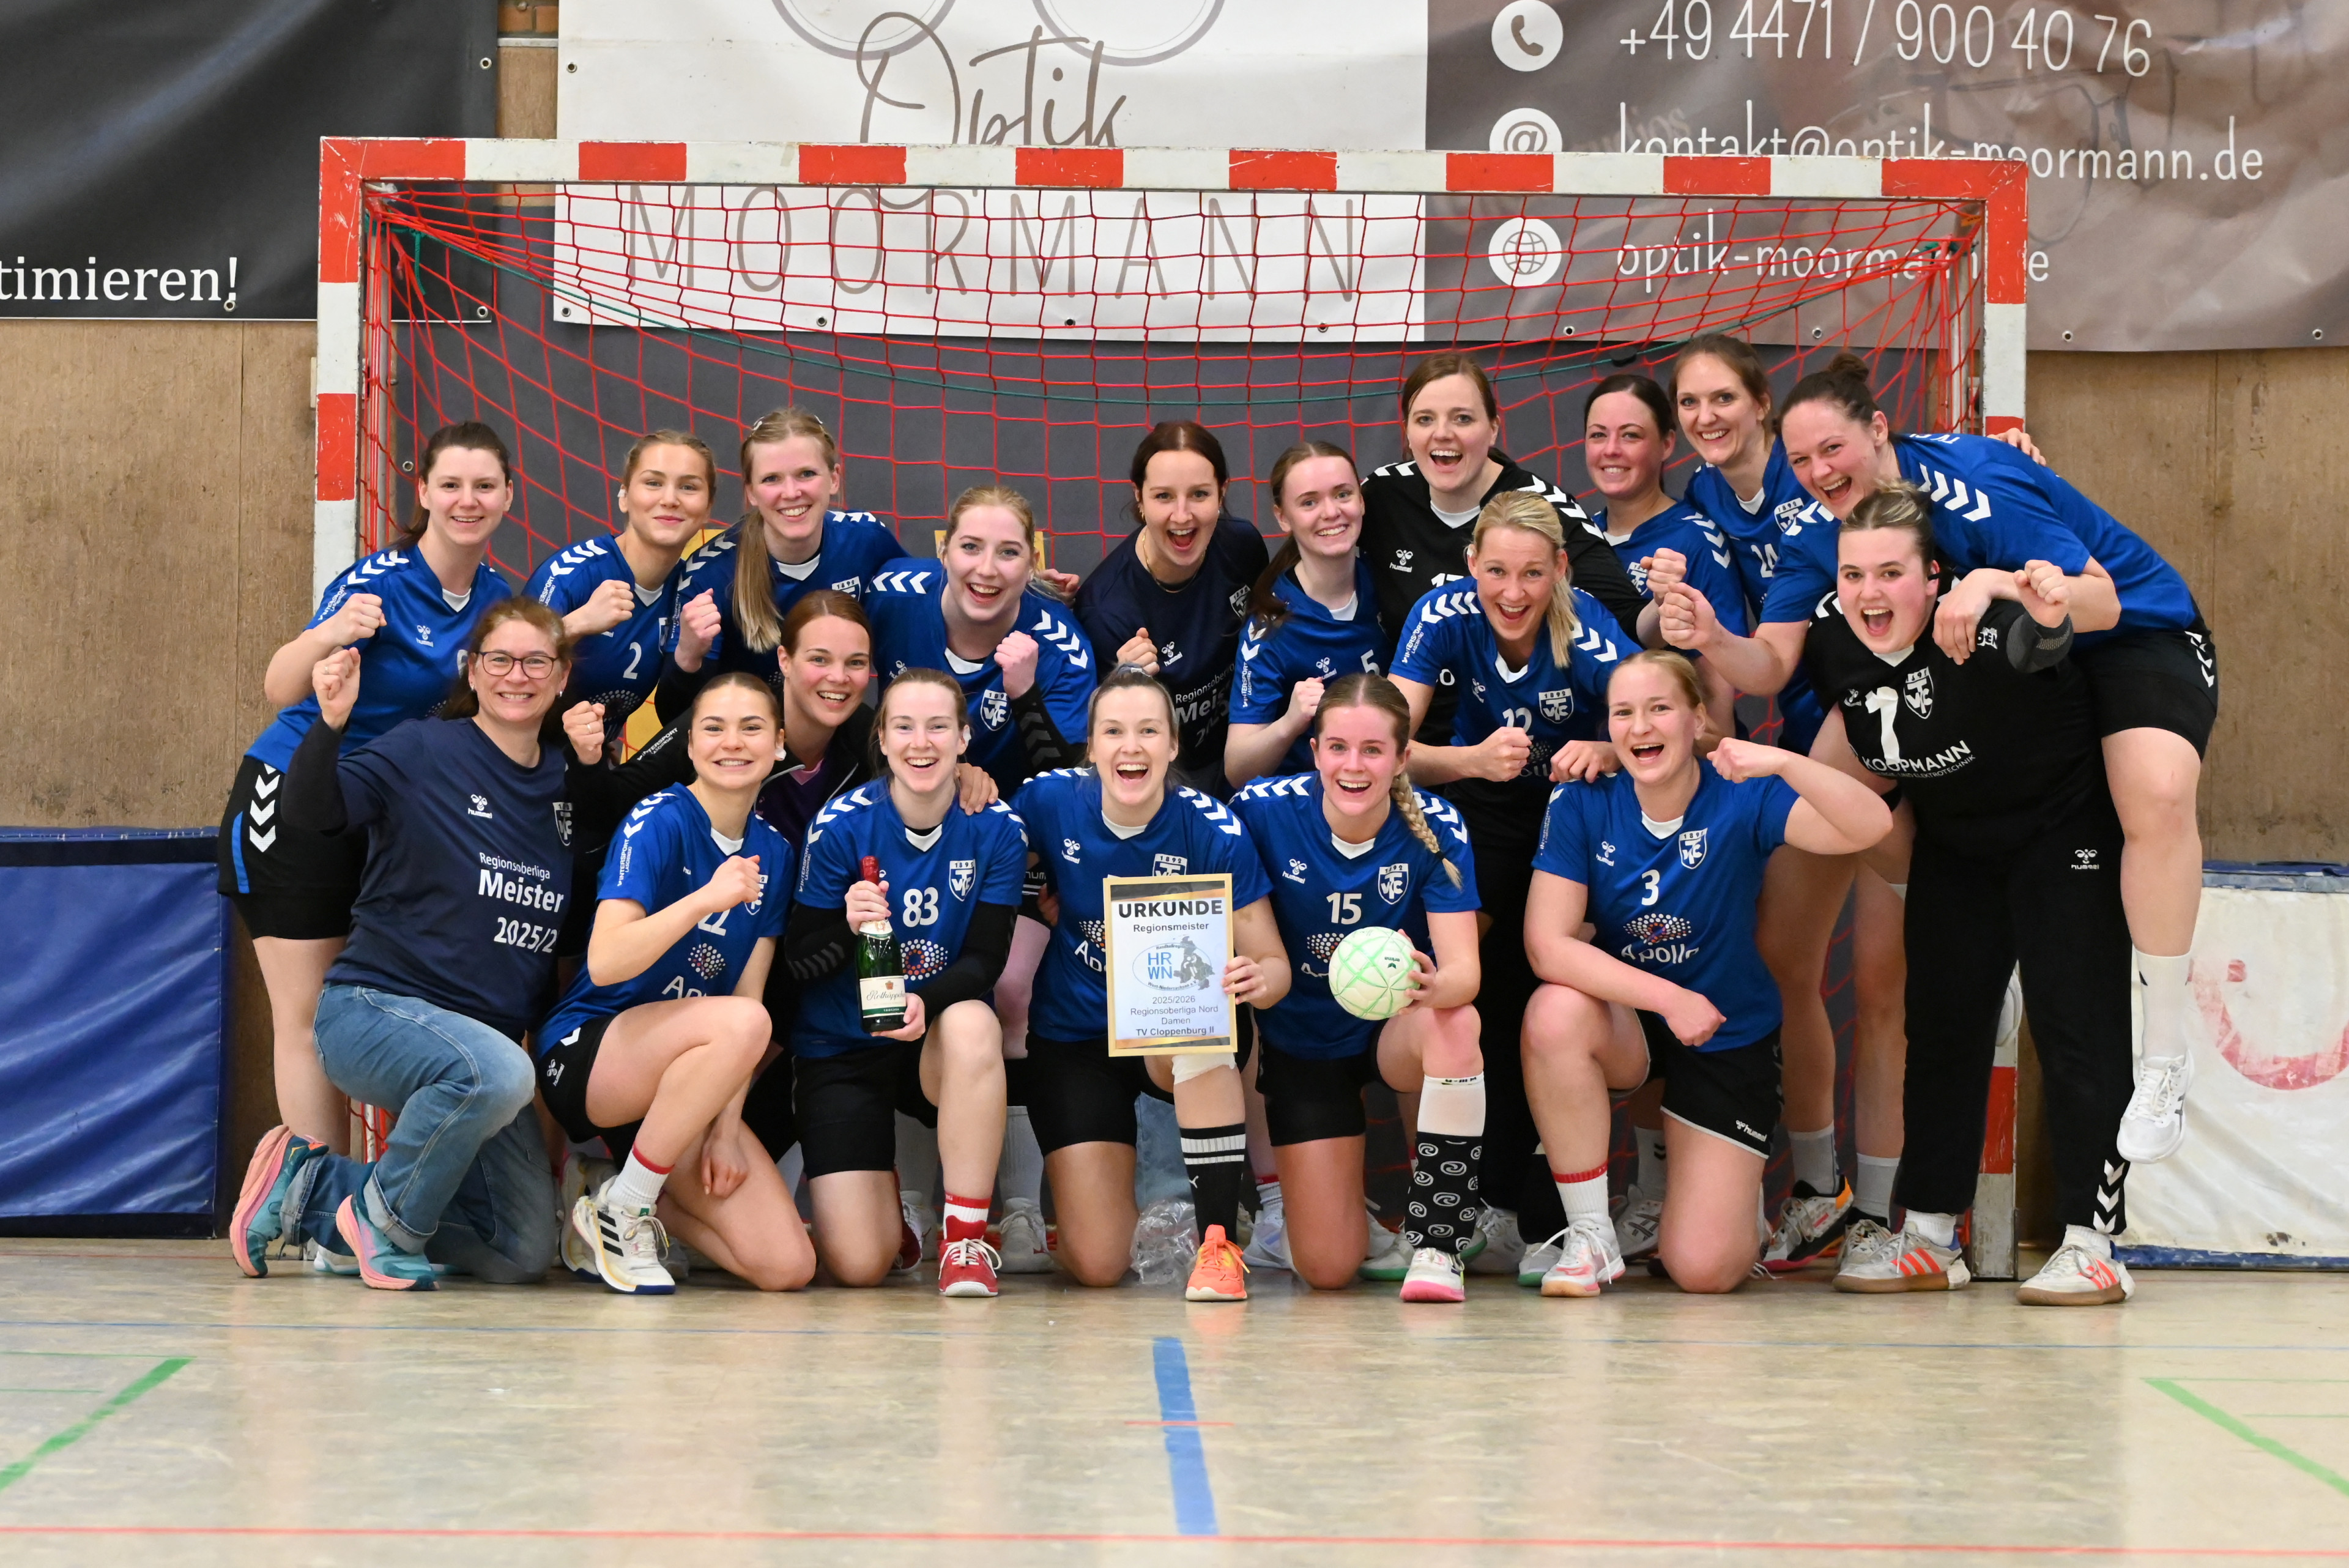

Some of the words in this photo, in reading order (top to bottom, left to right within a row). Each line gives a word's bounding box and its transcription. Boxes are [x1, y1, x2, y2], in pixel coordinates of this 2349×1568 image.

[1620, 0, 1712, 60] +49
[1730, 0, 1832, 59] 4471
[1853, 0, 1876, 65] /
[1895, 0, 1994, 67] 900
[2011, 8, 2073, 71] 40
[2094, 15, 2152, 77] 76
[629, 185, 1353, 302] MOORMANN
[0, 256, 238, 302] timieren!
[1389, 562, 1412, 573] hummel
[623, 642, 642, 680] 2
[467, 808, 492, 819] hummel
[479, 852, 551, 882] Regionsoberliga
[1160, 855, 1182, 864] 1892
[1282, 870, 1306, 885] hummel
[478, 869, 565, 913] Meister
[1641, 869, 1660, 906] 3
[902, 886, 939, 927] 83
[1118, 899, 1223, 918] URKUNDE
[1326, 892, 1362, 925] 15
[493, 916, 560, 953] 2025/2
[1133, 922, 1209, 934] Regionsmeister
[1148, 952, 1172, 966] HR
[1148, 966, 1173, 979] WN
[1152, 995, 1196, 1005] 2025/2026
[1130, 1006, 1196, 1017] Regionsoberliga
[1150, 1027, 1207, 1037] Cloppenburg
